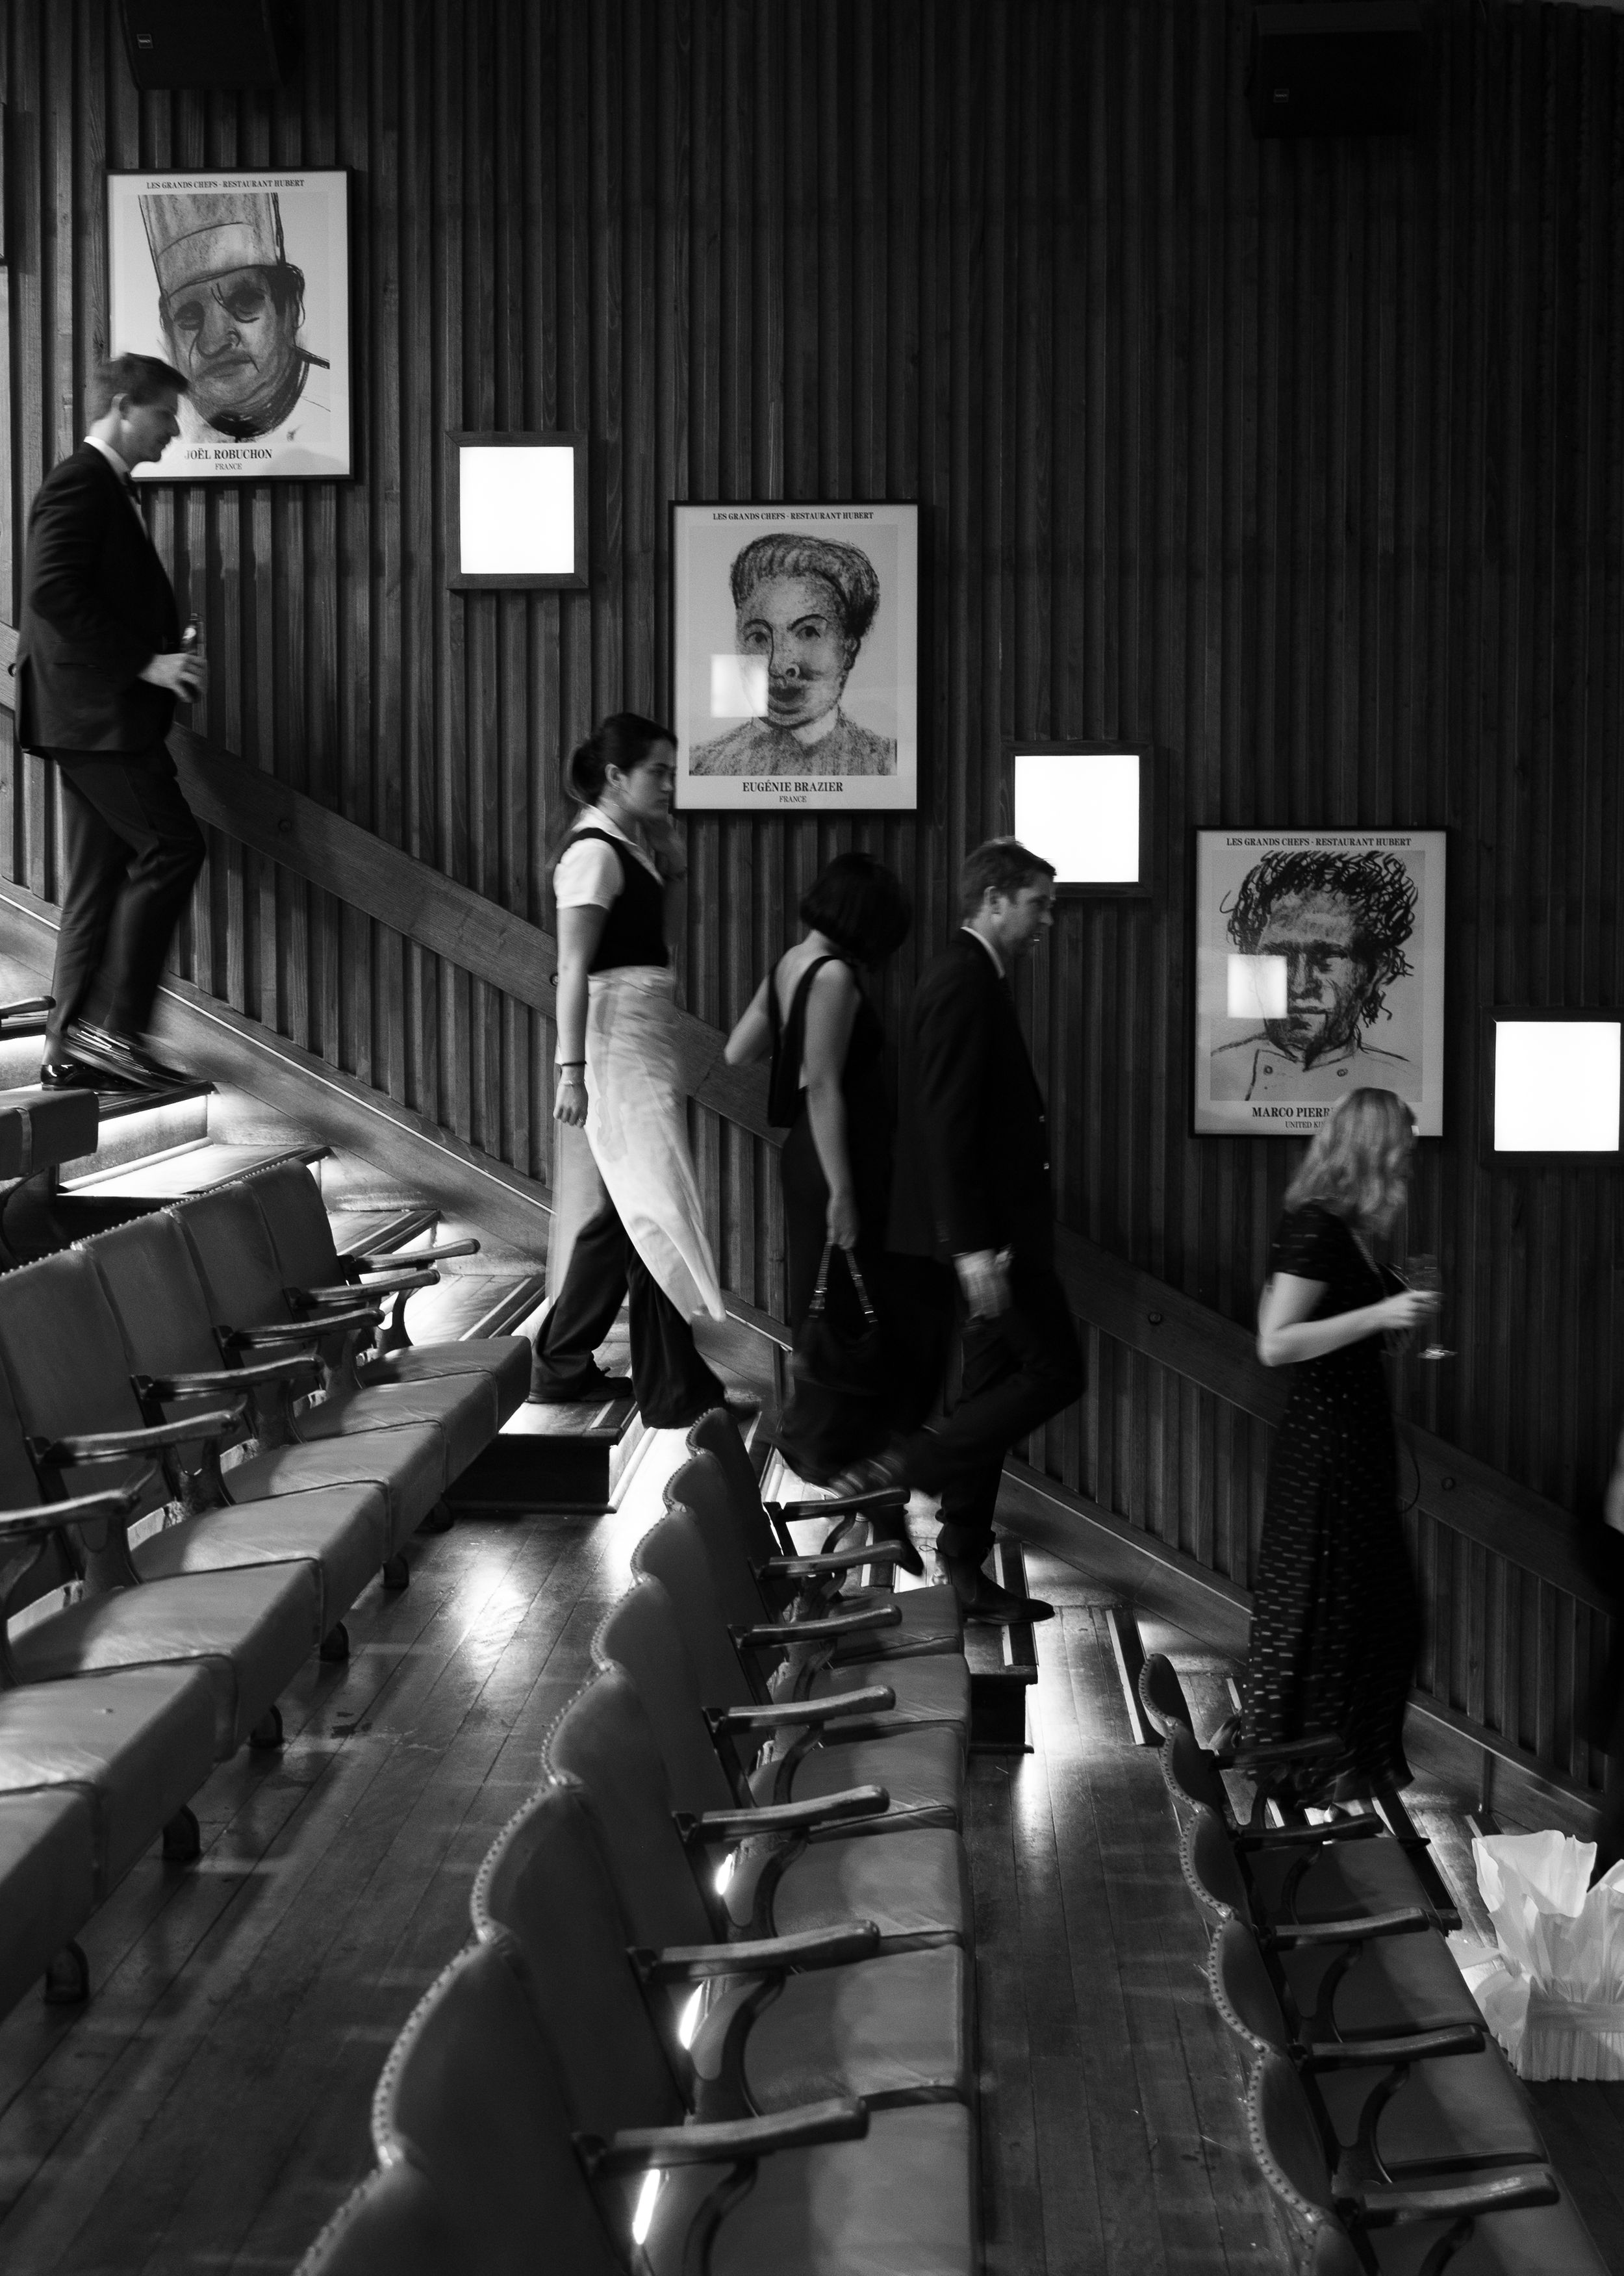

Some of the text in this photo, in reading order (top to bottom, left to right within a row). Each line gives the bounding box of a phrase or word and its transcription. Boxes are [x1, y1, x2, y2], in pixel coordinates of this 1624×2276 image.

[223, 180, 273, 188] RESTAURANT
[184, 448, 272, 459] JOËL ROBUCHON
[843, 511, 874, 520] HUBERT
[742, 780, 844, 792] EUGÉNIE BRAZIER
[1226, 838, 1243, 847] LES
[1244, 838, 1280, 847] GRANDS
[1281, 838, 1310, 847] CHEFS
[1315, 838, 1375, 847] RESTAURANT
[1375, 838, 1412, 847] HUBERT
[1252, 1106, 1334, 1118] MARCO PIERR
